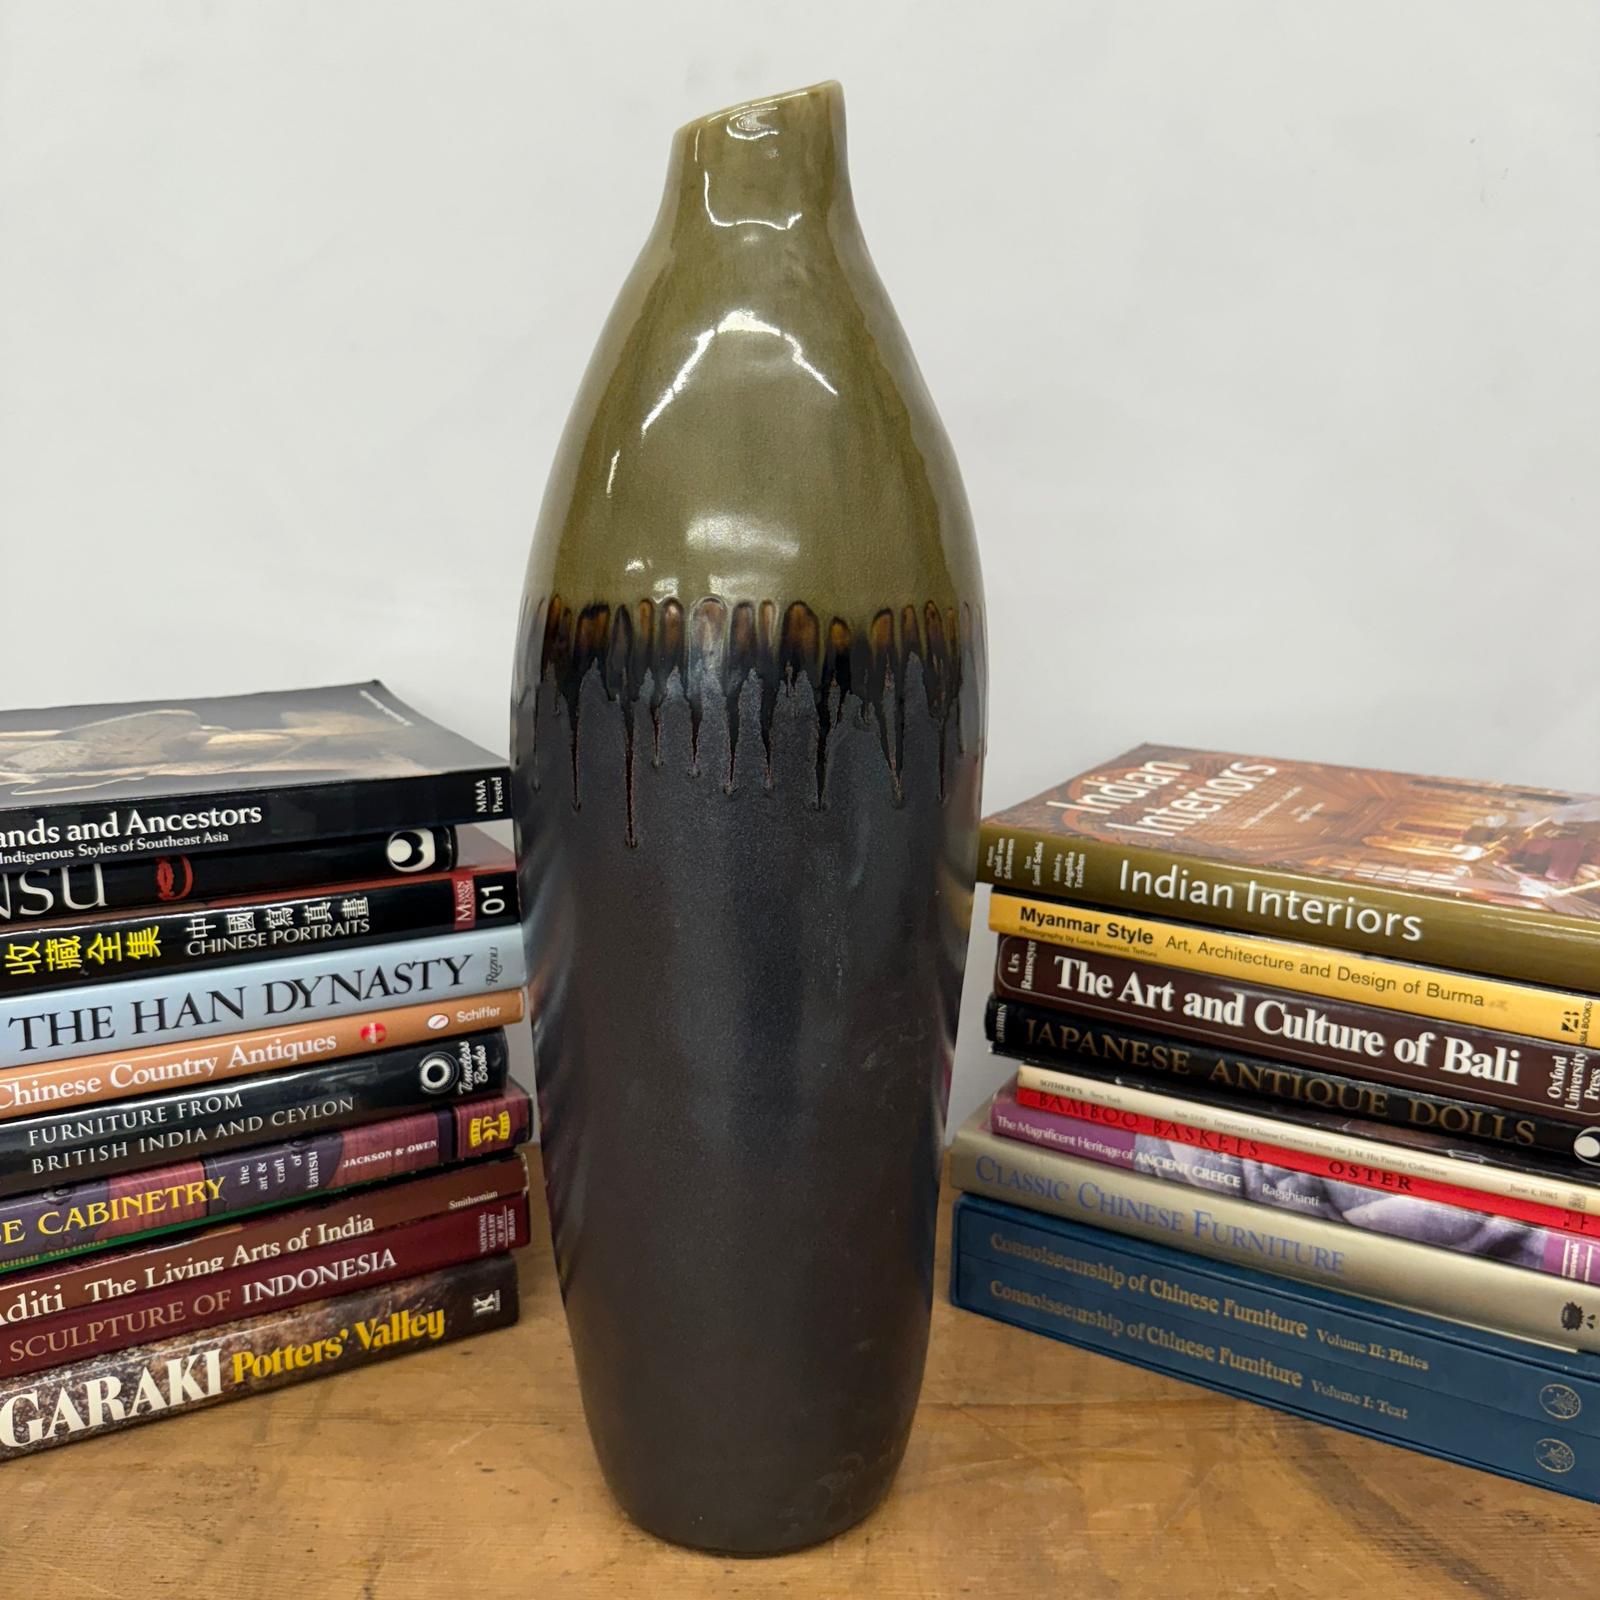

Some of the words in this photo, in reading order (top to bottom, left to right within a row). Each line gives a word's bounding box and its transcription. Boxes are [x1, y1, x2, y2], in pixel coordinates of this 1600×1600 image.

[476, 779, 488, 813] MMA
[492, 777, 504, 813] Prestel
[1046, 760, 1191, 815] Indian
[1105, 761, 1277, 836] Interiors
[0, 849, 74, 865] Indigenous
[78, 843, 118, 858] Styles
[121, 839, 135, 852] of
[137, 834, 200, 850] Southeast
[203, 832, 229, 845] Asia
[67, 811, 121, 842] and
[125, 806, 262, 836] Ancestors
[481, 885, 505, 915] 01
[1120, 859, 1233, 909] Indian
[1247, 880, 1423, 942] Interiors
[4, 925, 162, 976] 收藏全集
[186, 932, 267, 956] CHINESE
[273, 918, 370, 945] PORTRAITS
[1020, 906, 1101, 935] Myanmar
[1107, 922, 1154, 945] Style
[1165, 935, 1193, 953] Art,
[1197, 942, 1294, 971] Architecture
[1300, 963, 1331, 978] and
[1337, 966, 1396, 992] Design
[1403, 980, 1419, 994] of
[1426, 982, 1484, 1006] Burma
[1021, 941, 1037, 990] Ramseyer
[8, 1005, 116, 1051] THE
[130, 986, 247, 1035] HAN
[262, 954, 474, 1015] DYNASTY
[456, 1005, 501, 1023] Schiffer
[1054, 954, 1114, 998] The
[1117, 971, 1176, 1013] Art
[1183, 991, 1245, 1028] and
[1254, 999, 1385, 1057] Culture
[1394, 1031, 1438, 1067] of
[1440, 1035, 1521, 1086] Bali
[1582, 1001, 1592, 1030] BOOKS
[0, 1076, 102, 1110] Chinese
[110, 1056, 218, 1090] Country
[227, 1034, 337, 1068] Antiques
[457, 1041, 473, 1096] Timeless
[472, 1043, 488, 1084] Books
[1025, 1018, 1191, 1075] JAPANESE
[1209, 1058, 1389, 1116] ANTIQUE
[1409, 1097, 1536, 1146] DOLLS
[1547, 1055, 1567, 1099] Oxford
[1564, 1050, 1588, 1110] University
[1584, 1068, 1600, 1100] Press
[28, 1105, 168, 1147] FURNITURE
[177, 1093, 243, 1119] FROM
[31, 1140, 128, 1175] BRITISH
[139, 1127, 208, 1154] INDIA
[215, 1115, 263, 1140] AND
[271, 1097, 354, 1127] CEYLON
[1040, 1090, 1140, 1128] BAMBOO
[1153, 1119, 1259, 1156] BASKETS
[240, 1165, 250, 1185] the
[257, 1162, 267, 1173] &
[274, 1158, 285, 1183] craft
[291, 1154, 302, 1167] of
[307, 1151, 319, 1189] tansu
[343, 1149, 392, 1168] JACKSON
[395, 1146, 405, 1157] &
[407, 1139, 437, 1153] OWEN
[997, 1115, 1016, 1130] The
[1017, 1122, 1076, 1146] Magnificent
[1078, 1136, 1121, 1159] Heritage
[1121, 1149, 1135, 1160] of
[1135, 1152, 1187, 1175] ANCIENT
[1192, 1166, 1241, 1188] GREECE
[1329, 1161, 1414, 1191] OSTER
[259, 1176, 268, 1190] art
[449, 1190, 498, 1210] Smithsonian
[1262, 1183, 1320, 1207] Ragghianti
[0, 1218, 26, 1245] E
[37, 1176, 226, 1236] CABINETRY
[975, 1155, 1070, 1202] CLASSIC
[1078, 1181, 1184, 1233] CHINESE
[1193, 1208, 1345, 1274] FURNITURE
[84, 1278, 137, 1302] The
[144, 1255, 224, 1289] Living
[231, 1240, 281, 1267] Arts
[287, 1227, 311, 1251] of
[317, 1215, 374, 1243] India
[9, 1301, 186, 1363] SCULPTURE
[192, 1289, 231, 1316] OF
[241, 1249, 397, 1304] INDONESIA
[990, 1233, 1125, 1290] Connoisseurship
[1128, 1274, 1147, 1291] of
[1150, 1279, 1218, 1314] Chinese
[1223, 1298, 1309, 1340] Furniture
[1316, 1328, 1366, 1354] Volume
[1369, 1343, 1386, 1359] II:
[1389, 1348, 1429, 1370] Plates
[990, 1280, 1124, 1337] Connoisseurship
[1127, 1322, 1147, 1340] of
[1147, 1326, 1214, 1362] Chinese
[1219, 1347, 1303, 1387] Furniture
[1311, 1379, 1361, 1406] Volume
[1377, 1400, 1408, 1420] Text
[0, 1350, 223, 1447] GARAKI
[232, 1328, 348, 1384] Potters'
[355, 1309, 445, 1350] Valley
